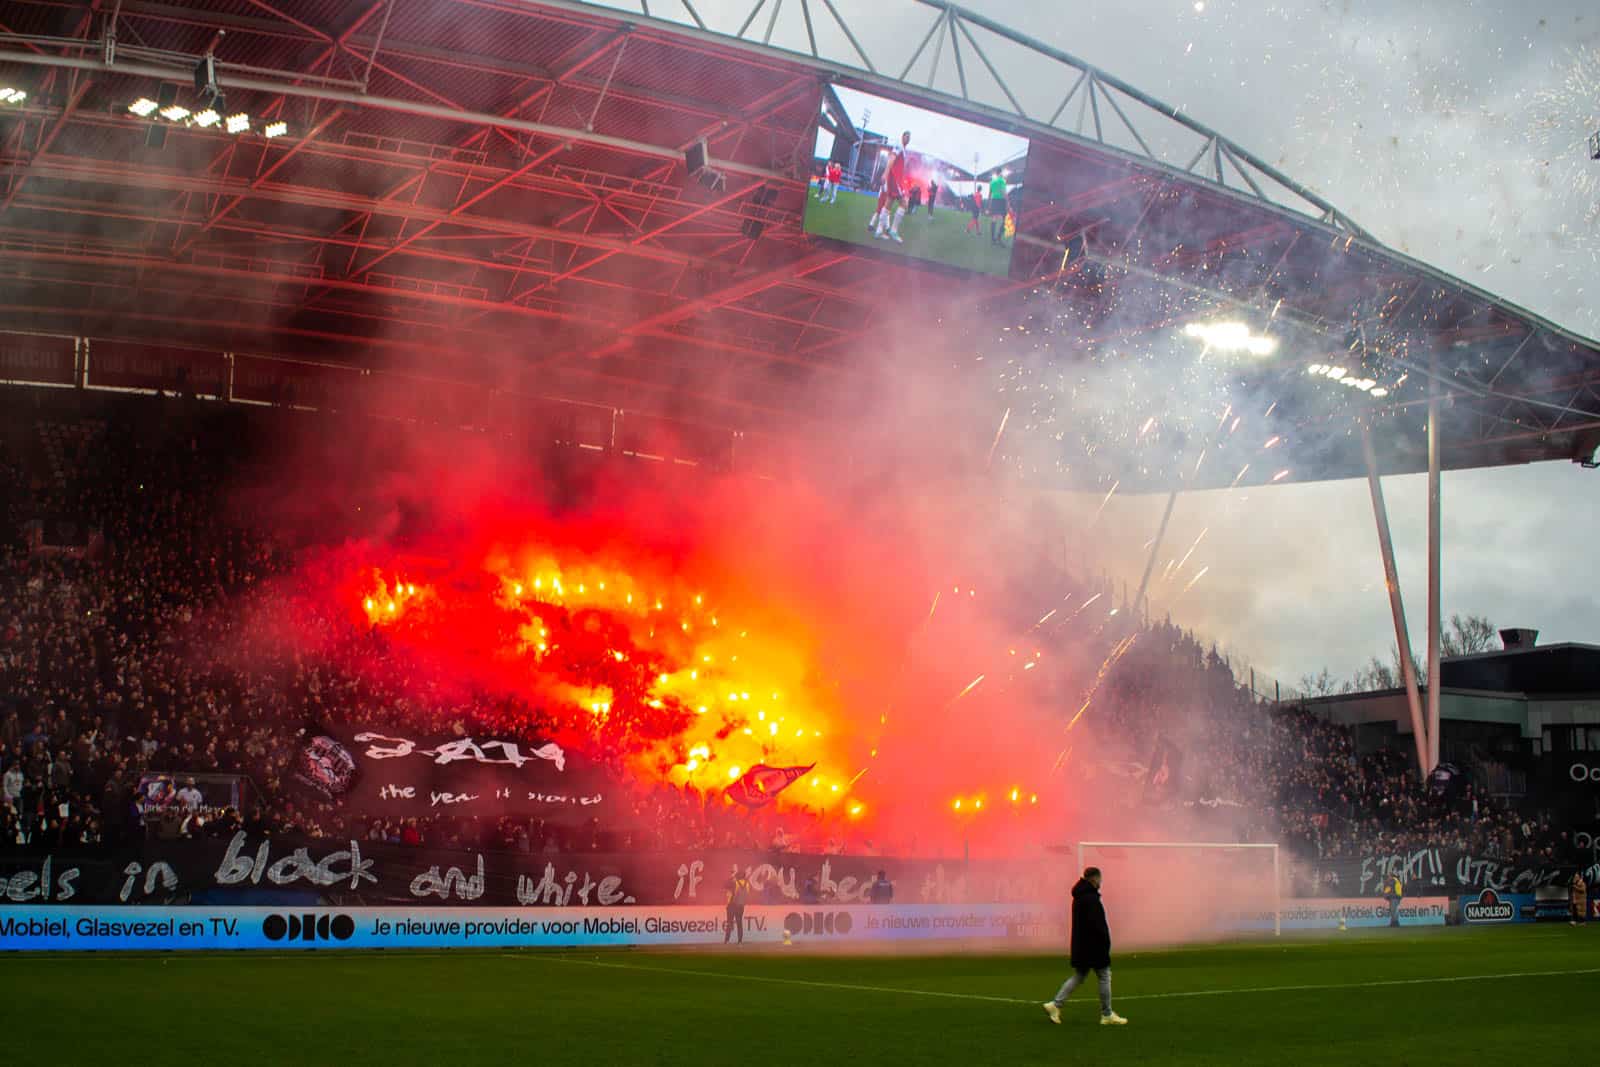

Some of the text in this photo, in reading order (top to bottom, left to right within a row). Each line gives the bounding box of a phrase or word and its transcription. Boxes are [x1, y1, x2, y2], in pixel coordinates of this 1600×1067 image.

[377, 783, 417, 801] the
[119, 860, 179, 903] in
[213, 829, 379, 891] black
[409, 852, 486, 901] and
[516, 860, 637, 906] white.
[673, 859, 705, 900] if
[1375, 904, 1417, 919] Glaezel
[1418, 905, 1431, 918] en
[1467, 904, 1512, 919] NAPOLEON
[0, 917, 241, 940] Mobiel, Glasvezel en TV.
[370, 918, 392, 937] Je
[394, 918, 461, 936] nieuwe
[464, 917, 538, 940] provider
[541, 920, 581, 936] voor
[583, 916, 641, 937] Mobiel,
[645, 916, 718, 934] Glasvezel
[743, 915, 768, 932] TV.
[881, 914, 930, 930] nieuwe
